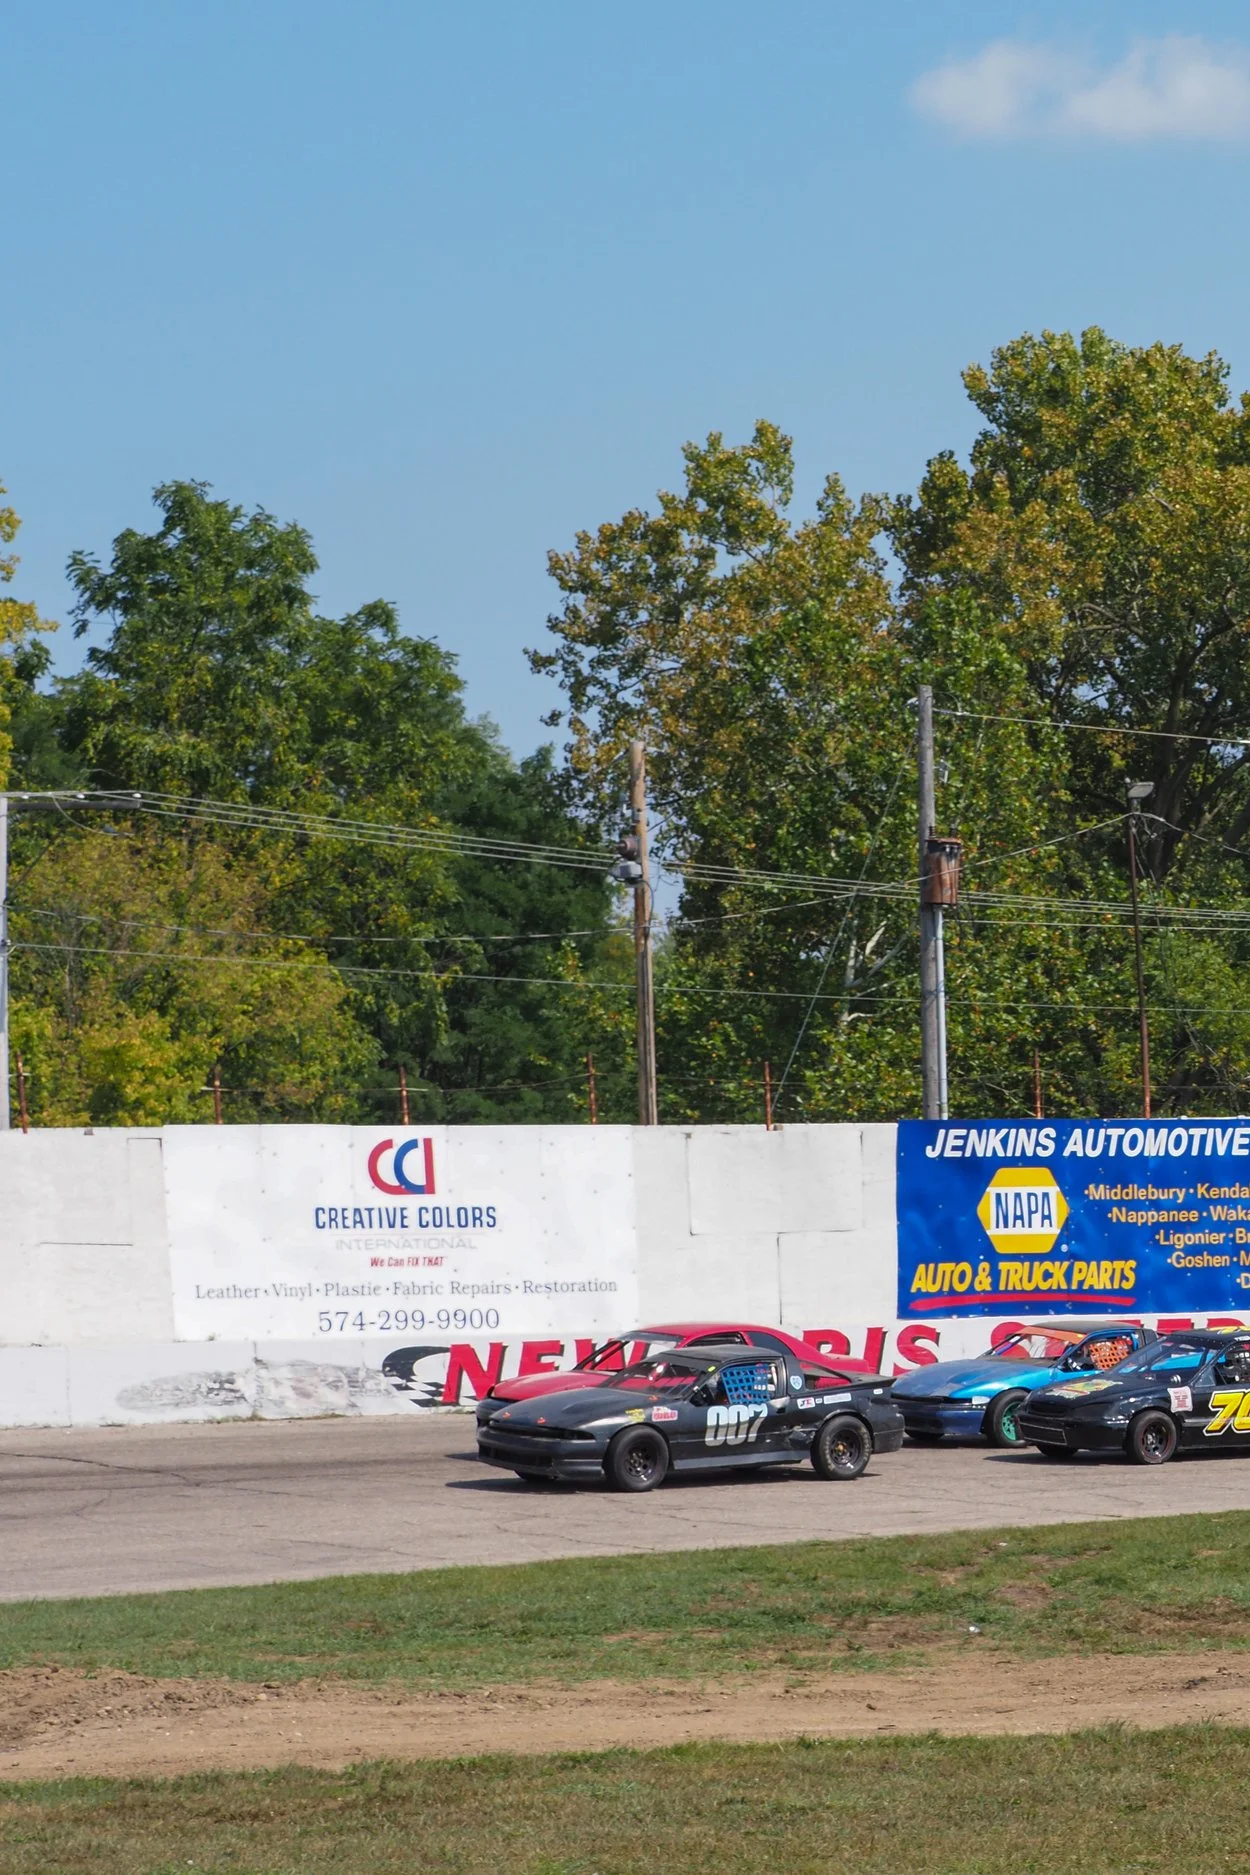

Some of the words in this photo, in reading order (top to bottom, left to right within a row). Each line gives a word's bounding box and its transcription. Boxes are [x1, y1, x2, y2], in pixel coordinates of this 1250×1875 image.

[926, 1127, 1057, 1158] JENKINS
[1088, 1184, 1186, 1203] Middlebury
[315, 1206, 409, 1229] CREATIVE
[418, 1206, 497, 1228] COLORS
[994, 1191, 1053, 1229] NAPA
[1112, 1207, 1199, 1226] Nappanee
[335, 1237, 477, 1251] INTERNATIONAL
[1159, 1229, 1226, 1248] Ligonier
[370, 1257, 384, 1268] We
[387, 1256, 404, 1267] Can
[407, 1256, 419, 1267] FIX
[422, 1256, 444, 1267] THAT
[1171, 1251, 1230, 1268] Goshen
[910, 1262, 973, 1293] AUTO
[974, 1262, 992, 1291] &
[998, 1261, 1070, 1291] TRUCK
[1071, 1260, 1137, 1290] PARTS
[195, 1284, 261, 1300] Leather
[271, 1282, 313, 1301] Vinyl
[393, 1280, 444, 1296] Fabric
[450, 1280, 511, 1299] Repairs
[523, 1277, 618, 1293] Restoration
[318, 1308, 500, 1332] 574-299-9900
[704, 1404, 768, 1447] 007
